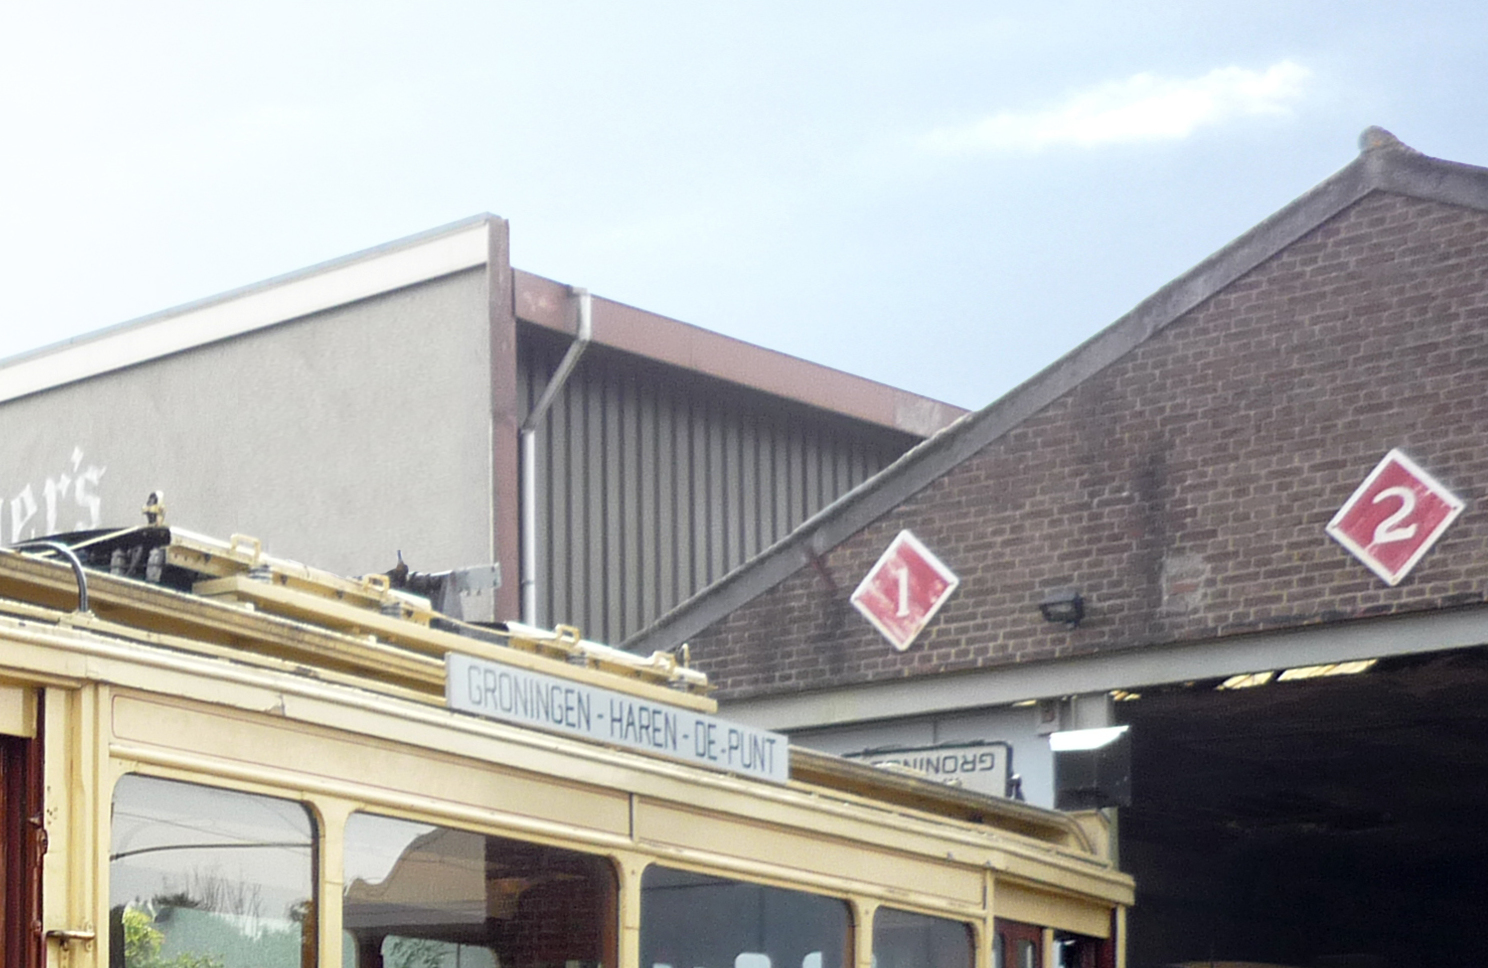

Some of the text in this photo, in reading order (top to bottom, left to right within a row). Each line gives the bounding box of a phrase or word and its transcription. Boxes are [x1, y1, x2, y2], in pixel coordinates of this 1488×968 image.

[1372, 486, 1417, 544] 2
[891, 566, 911, 618] 1
[467, 664, 591, 732] GRONINGEN
[610, 699, 677, 750] HAREN
